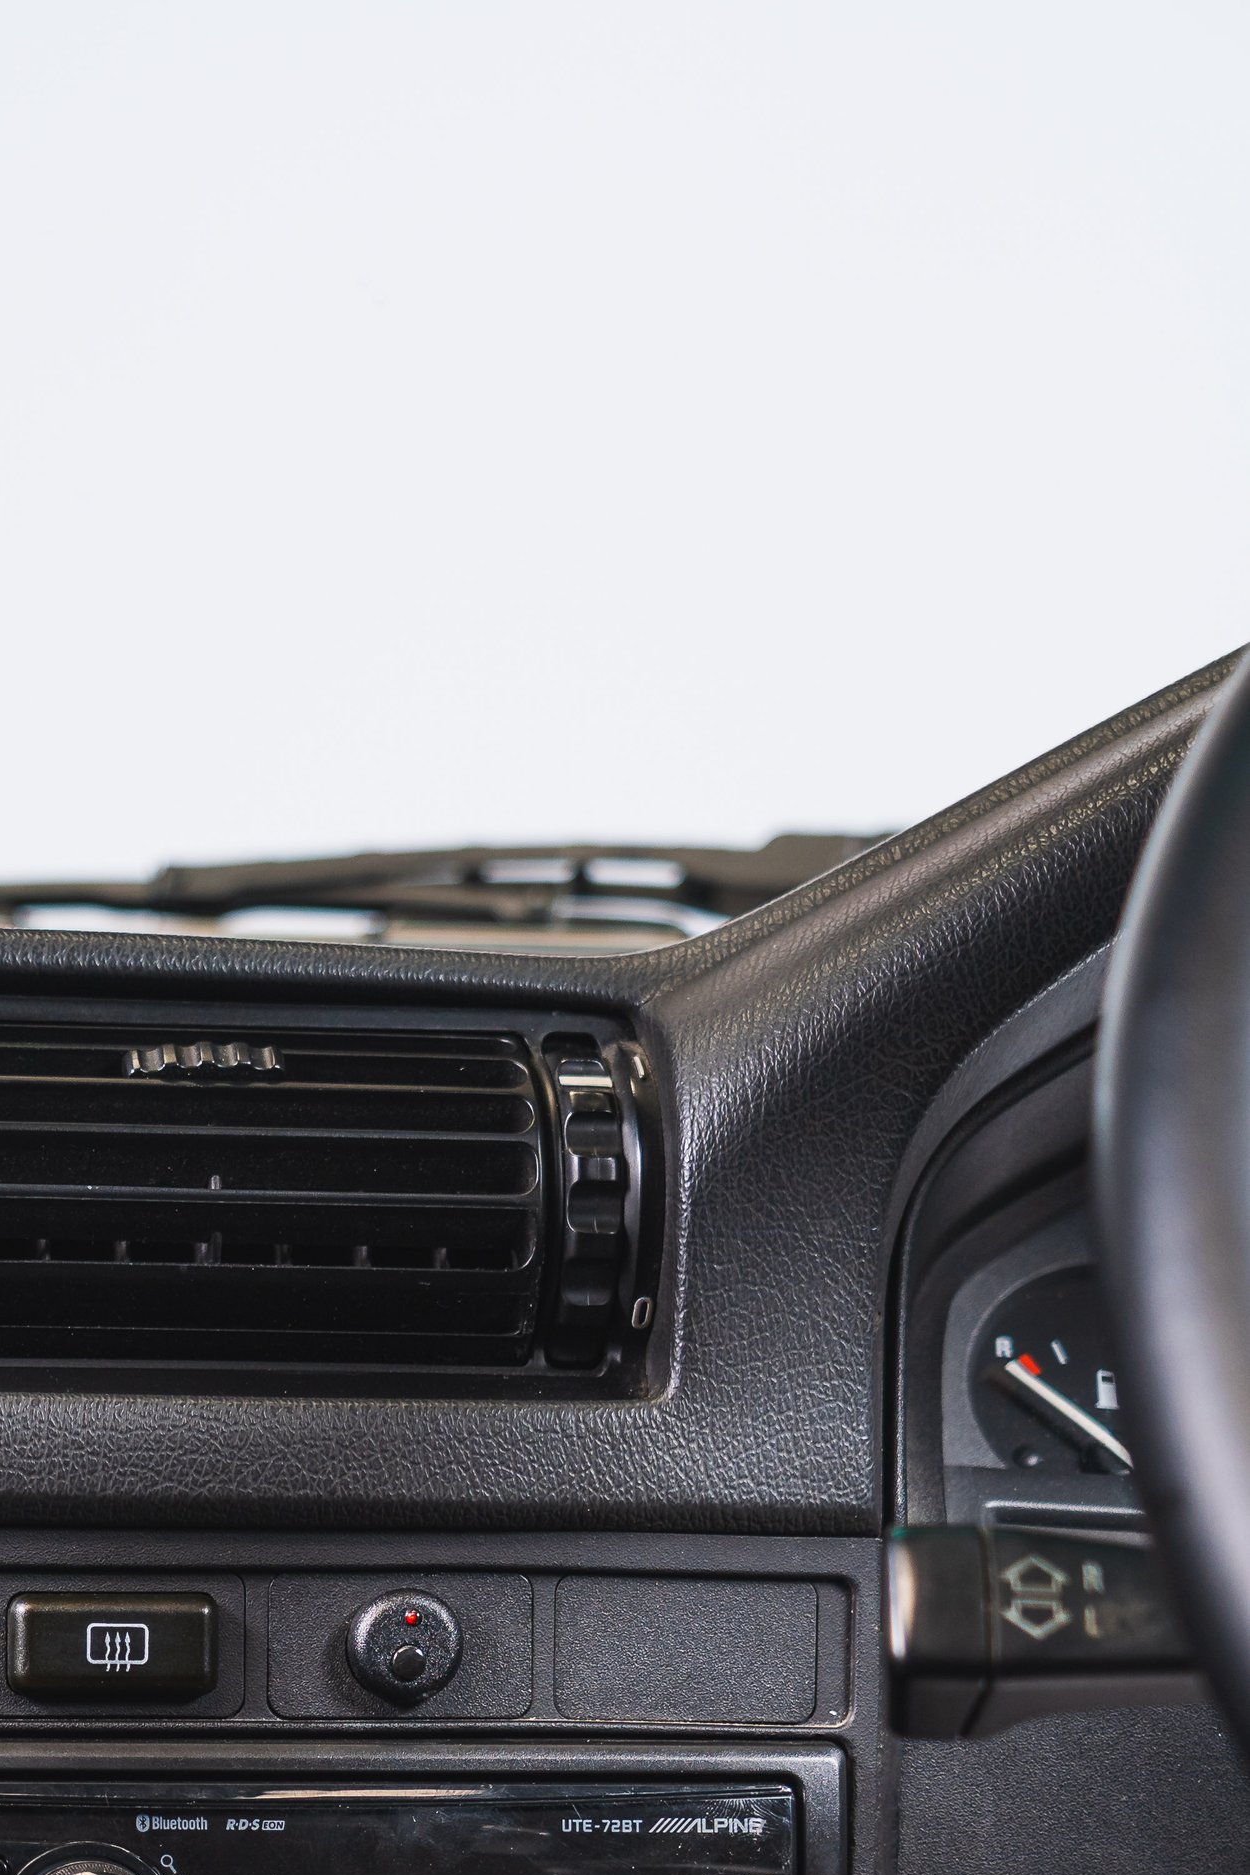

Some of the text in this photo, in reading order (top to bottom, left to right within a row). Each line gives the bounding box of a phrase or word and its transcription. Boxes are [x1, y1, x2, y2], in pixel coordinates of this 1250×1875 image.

[995, 1336, 1015, 1358] R
[152, 1817, 208, 1830] Bluetooth
[262, 1820, 286, 1831] EON
[561, 1819, 643, 1833] UTE-72BT
[684, 1817, 765, 1833] ALPINE
